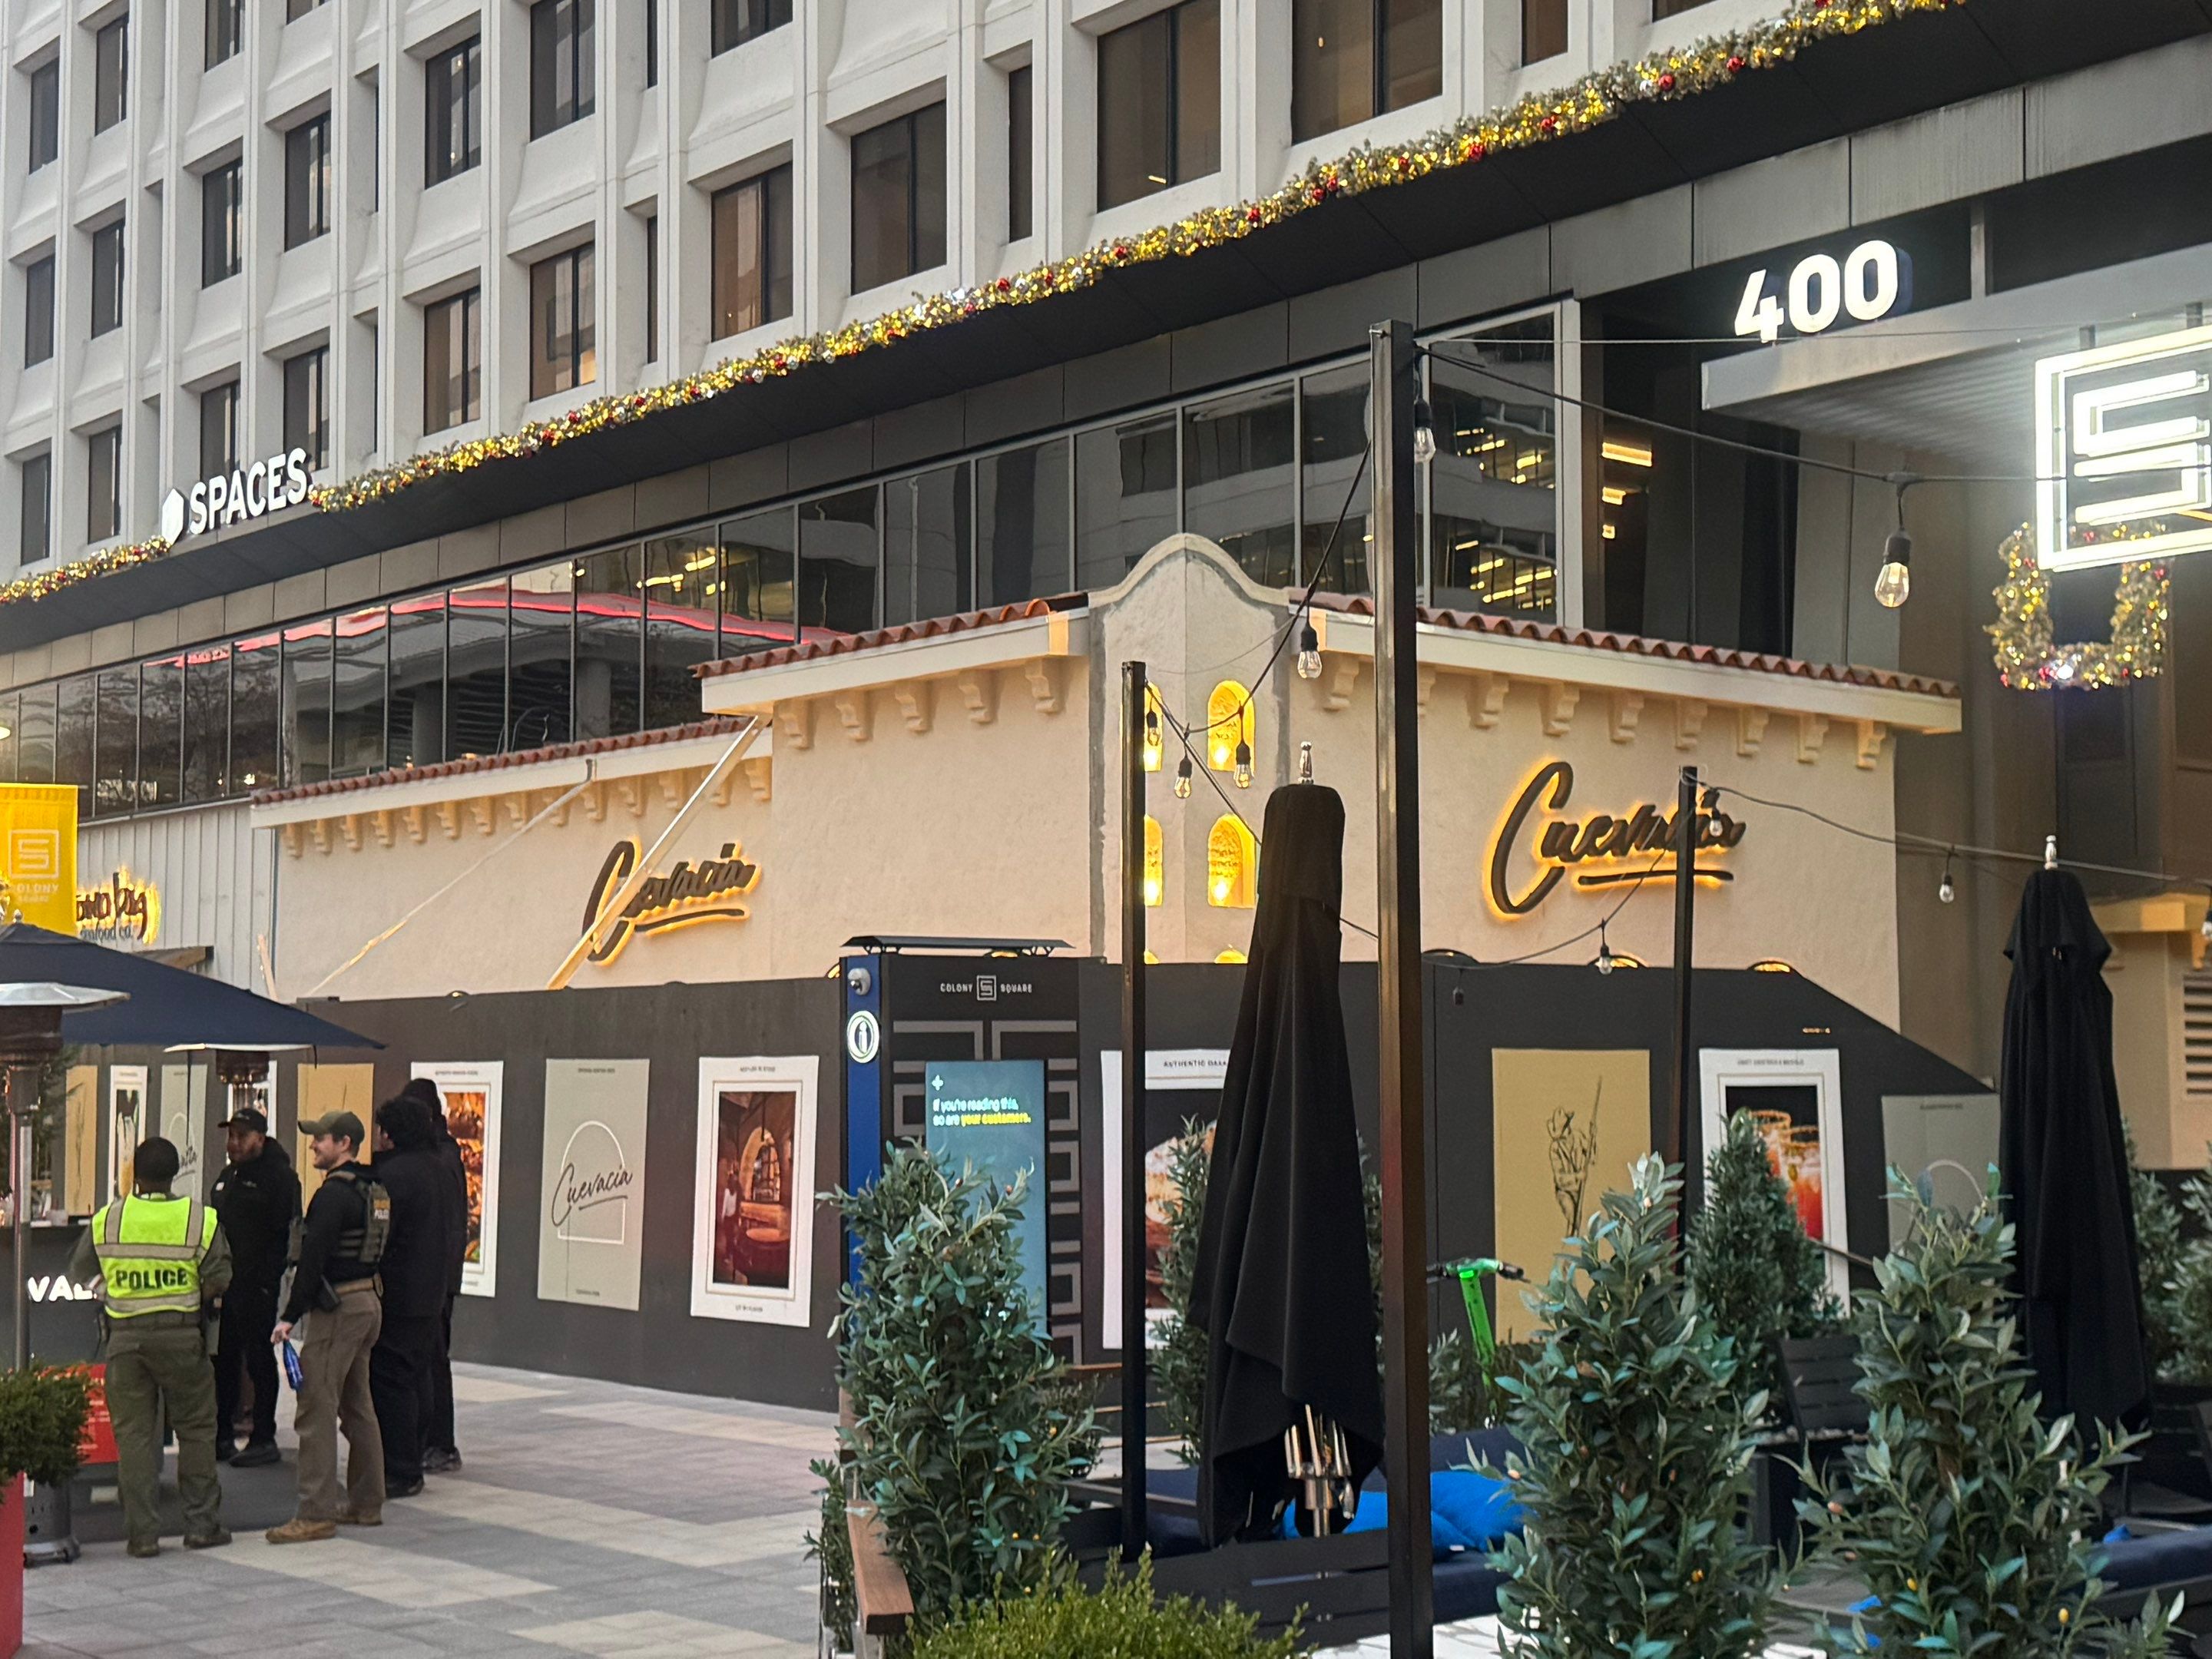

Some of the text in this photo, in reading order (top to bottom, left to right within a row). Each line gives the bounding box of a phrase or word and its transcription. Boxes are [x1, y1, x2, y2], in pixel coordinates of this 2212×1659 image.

[1733, 238, 1900, 343] 400
[15, 882, 59, 893] OLONY
[939, 982, 974, 993] COLONY
[999, 982, 1034, 994] SQUARE
[967, 1097, 1000, 1112] reading
[945, 1114, 960, 1126] are
[960, 1113, 982, 1128] your
[551, 1161, 634, 1227] Cuevacia
[115, 1267, 190, 1290] POLICE
[27, 1274, 98, 1303] VAL
